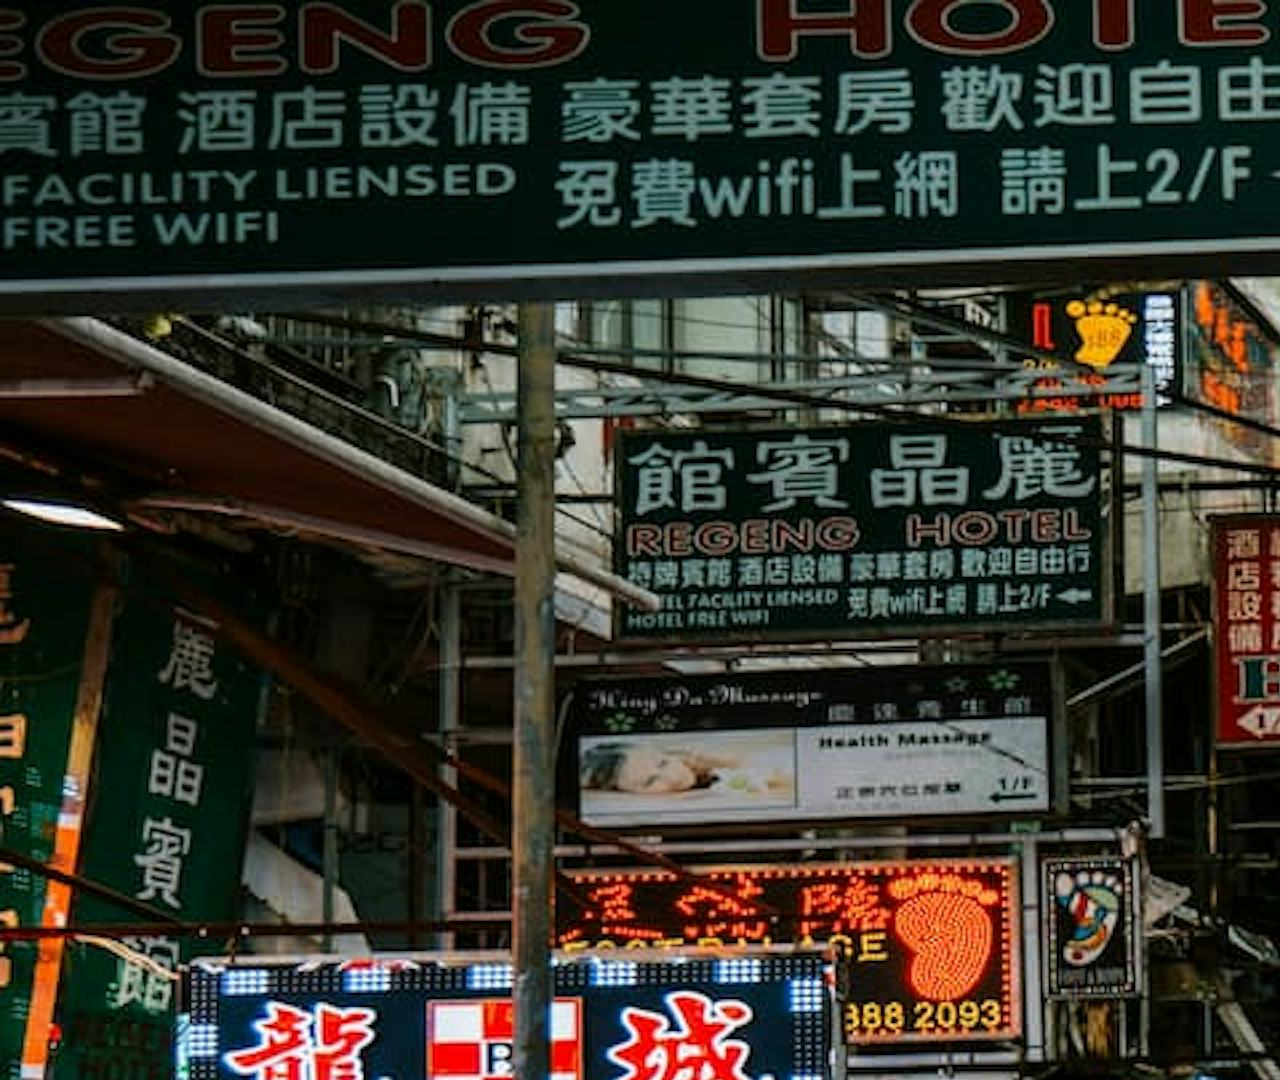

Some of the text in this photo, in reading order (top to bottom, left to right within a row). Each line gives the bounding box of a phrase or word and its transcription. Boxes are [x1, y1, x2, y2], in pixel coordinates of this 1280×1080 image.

[0, 0, 590, 80] GENG
[178, 83, 531, 153] 酒店設備
[560, 68, 915, 144] 豪華套房
[3, 164, 516, 205] FACILITY LIENSED
[1000, 144, 1253, 217] 請上2/F
[4, 211, 279, 248] FREE WIFI
[625, 508, 1092, 557] REGENG HOTEL
[627, 612, 684, 629] HOTEL
[686, 610, 728, 627] FREE
[819, 732, 992, 748] Health Massage
[914, 1002, 1000, 1030] 2093
